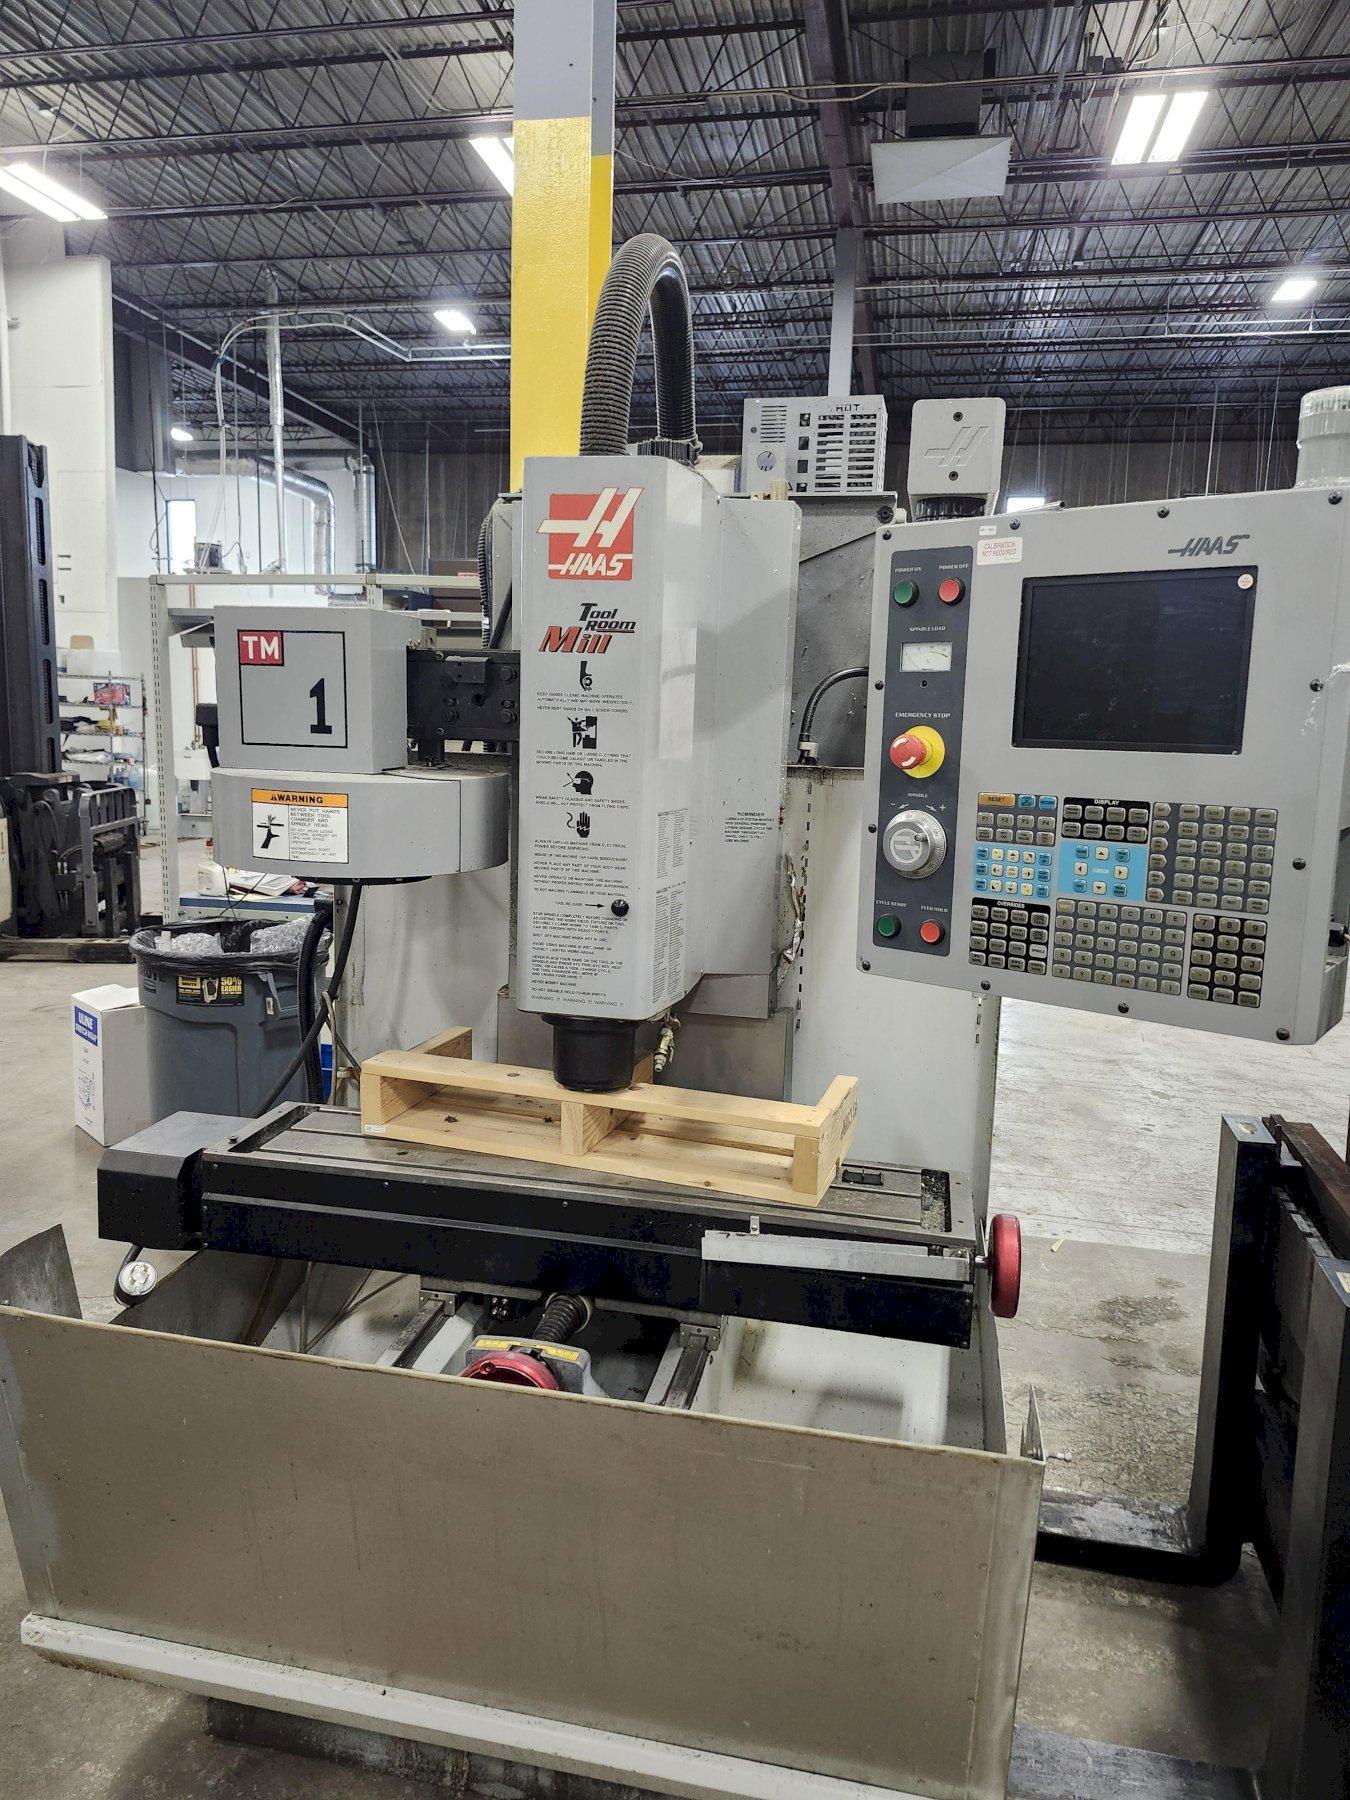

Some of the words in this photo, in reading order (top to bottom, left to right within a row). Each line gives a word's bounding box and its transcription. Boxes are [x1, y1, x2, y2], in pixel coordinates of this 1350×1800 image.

[1168, 534, 1250, 557] HAAS
[548, 553, 633, 576] HAAS
[242, 636, 279, 660] TM
[538, 626, 612, 654] Mill
[310, 678, 332, 734] 1
[276, 794, 323, 804] WARNING
[221, 976, 242, 985] 50%
